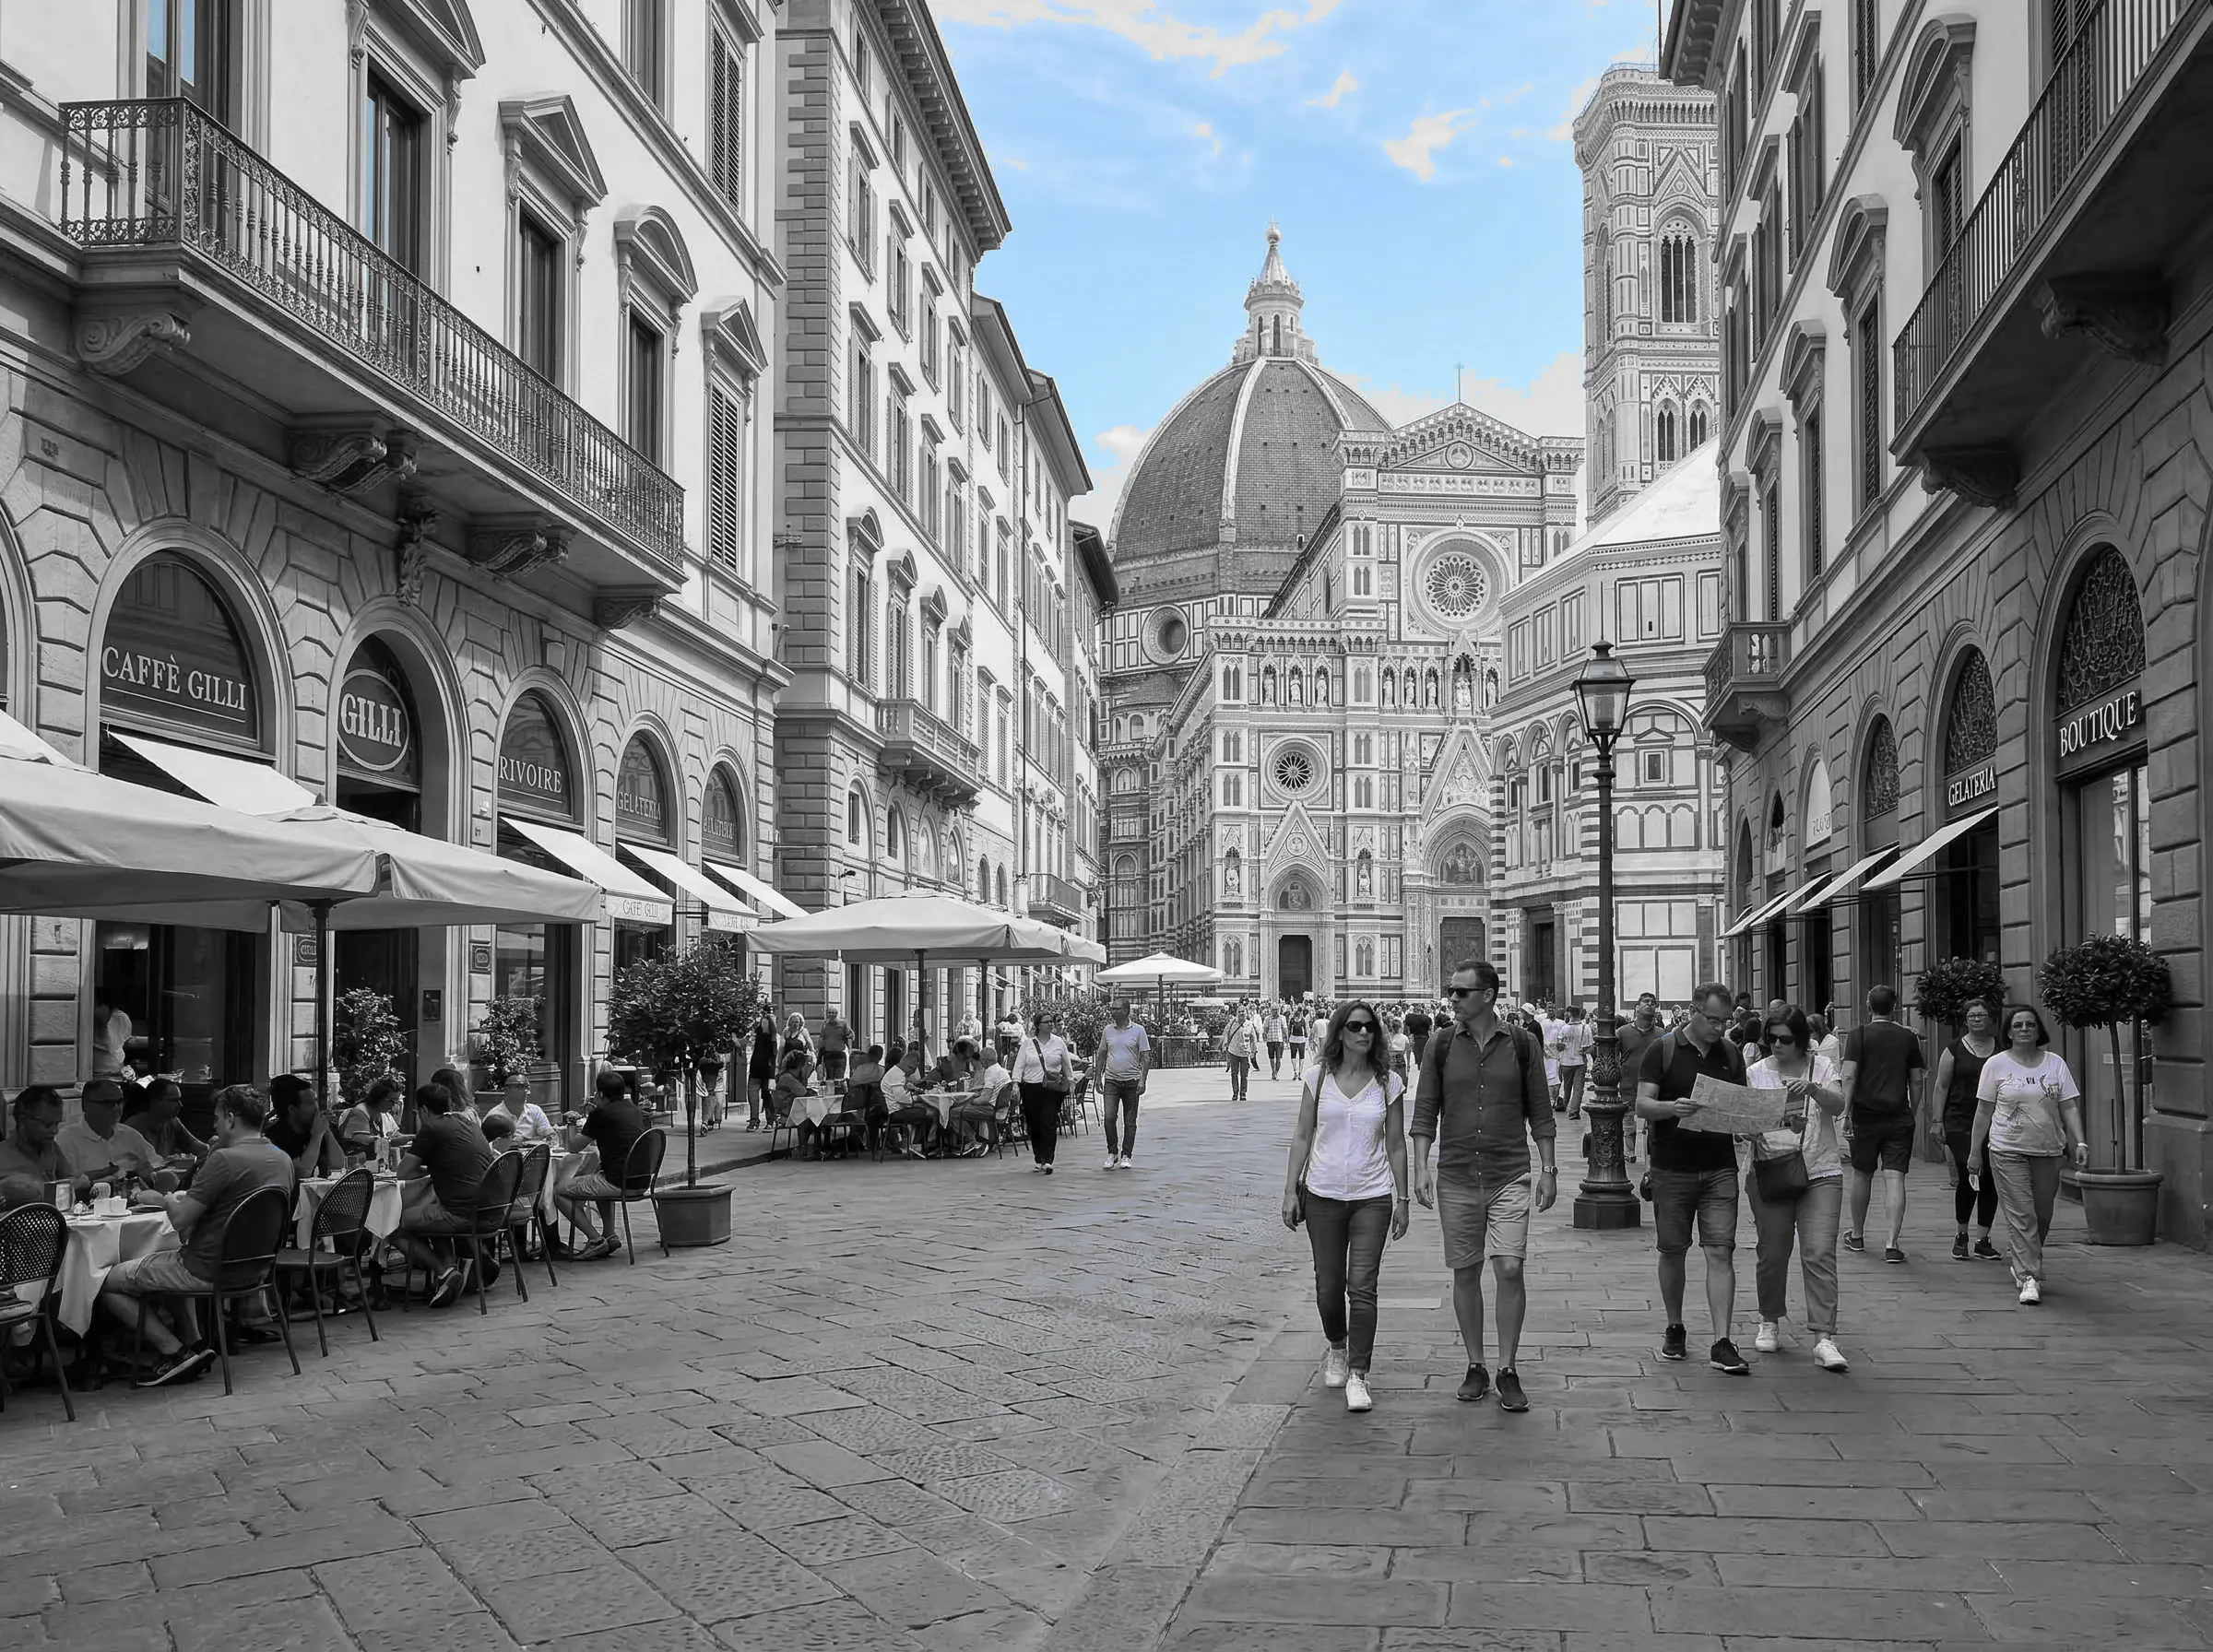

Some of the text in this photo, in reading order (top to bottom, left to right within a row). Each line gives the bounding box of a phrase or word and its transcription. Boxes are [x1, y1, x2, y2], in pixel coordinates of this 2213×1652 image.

[101, 646, 247, 711] CAFFÈ GILLI
[340, 693, 402, 748] GILLI
[2059, 690, 2136, 758] BOUTIQUE
[499, 755, 562, 794] RIVOIRE
